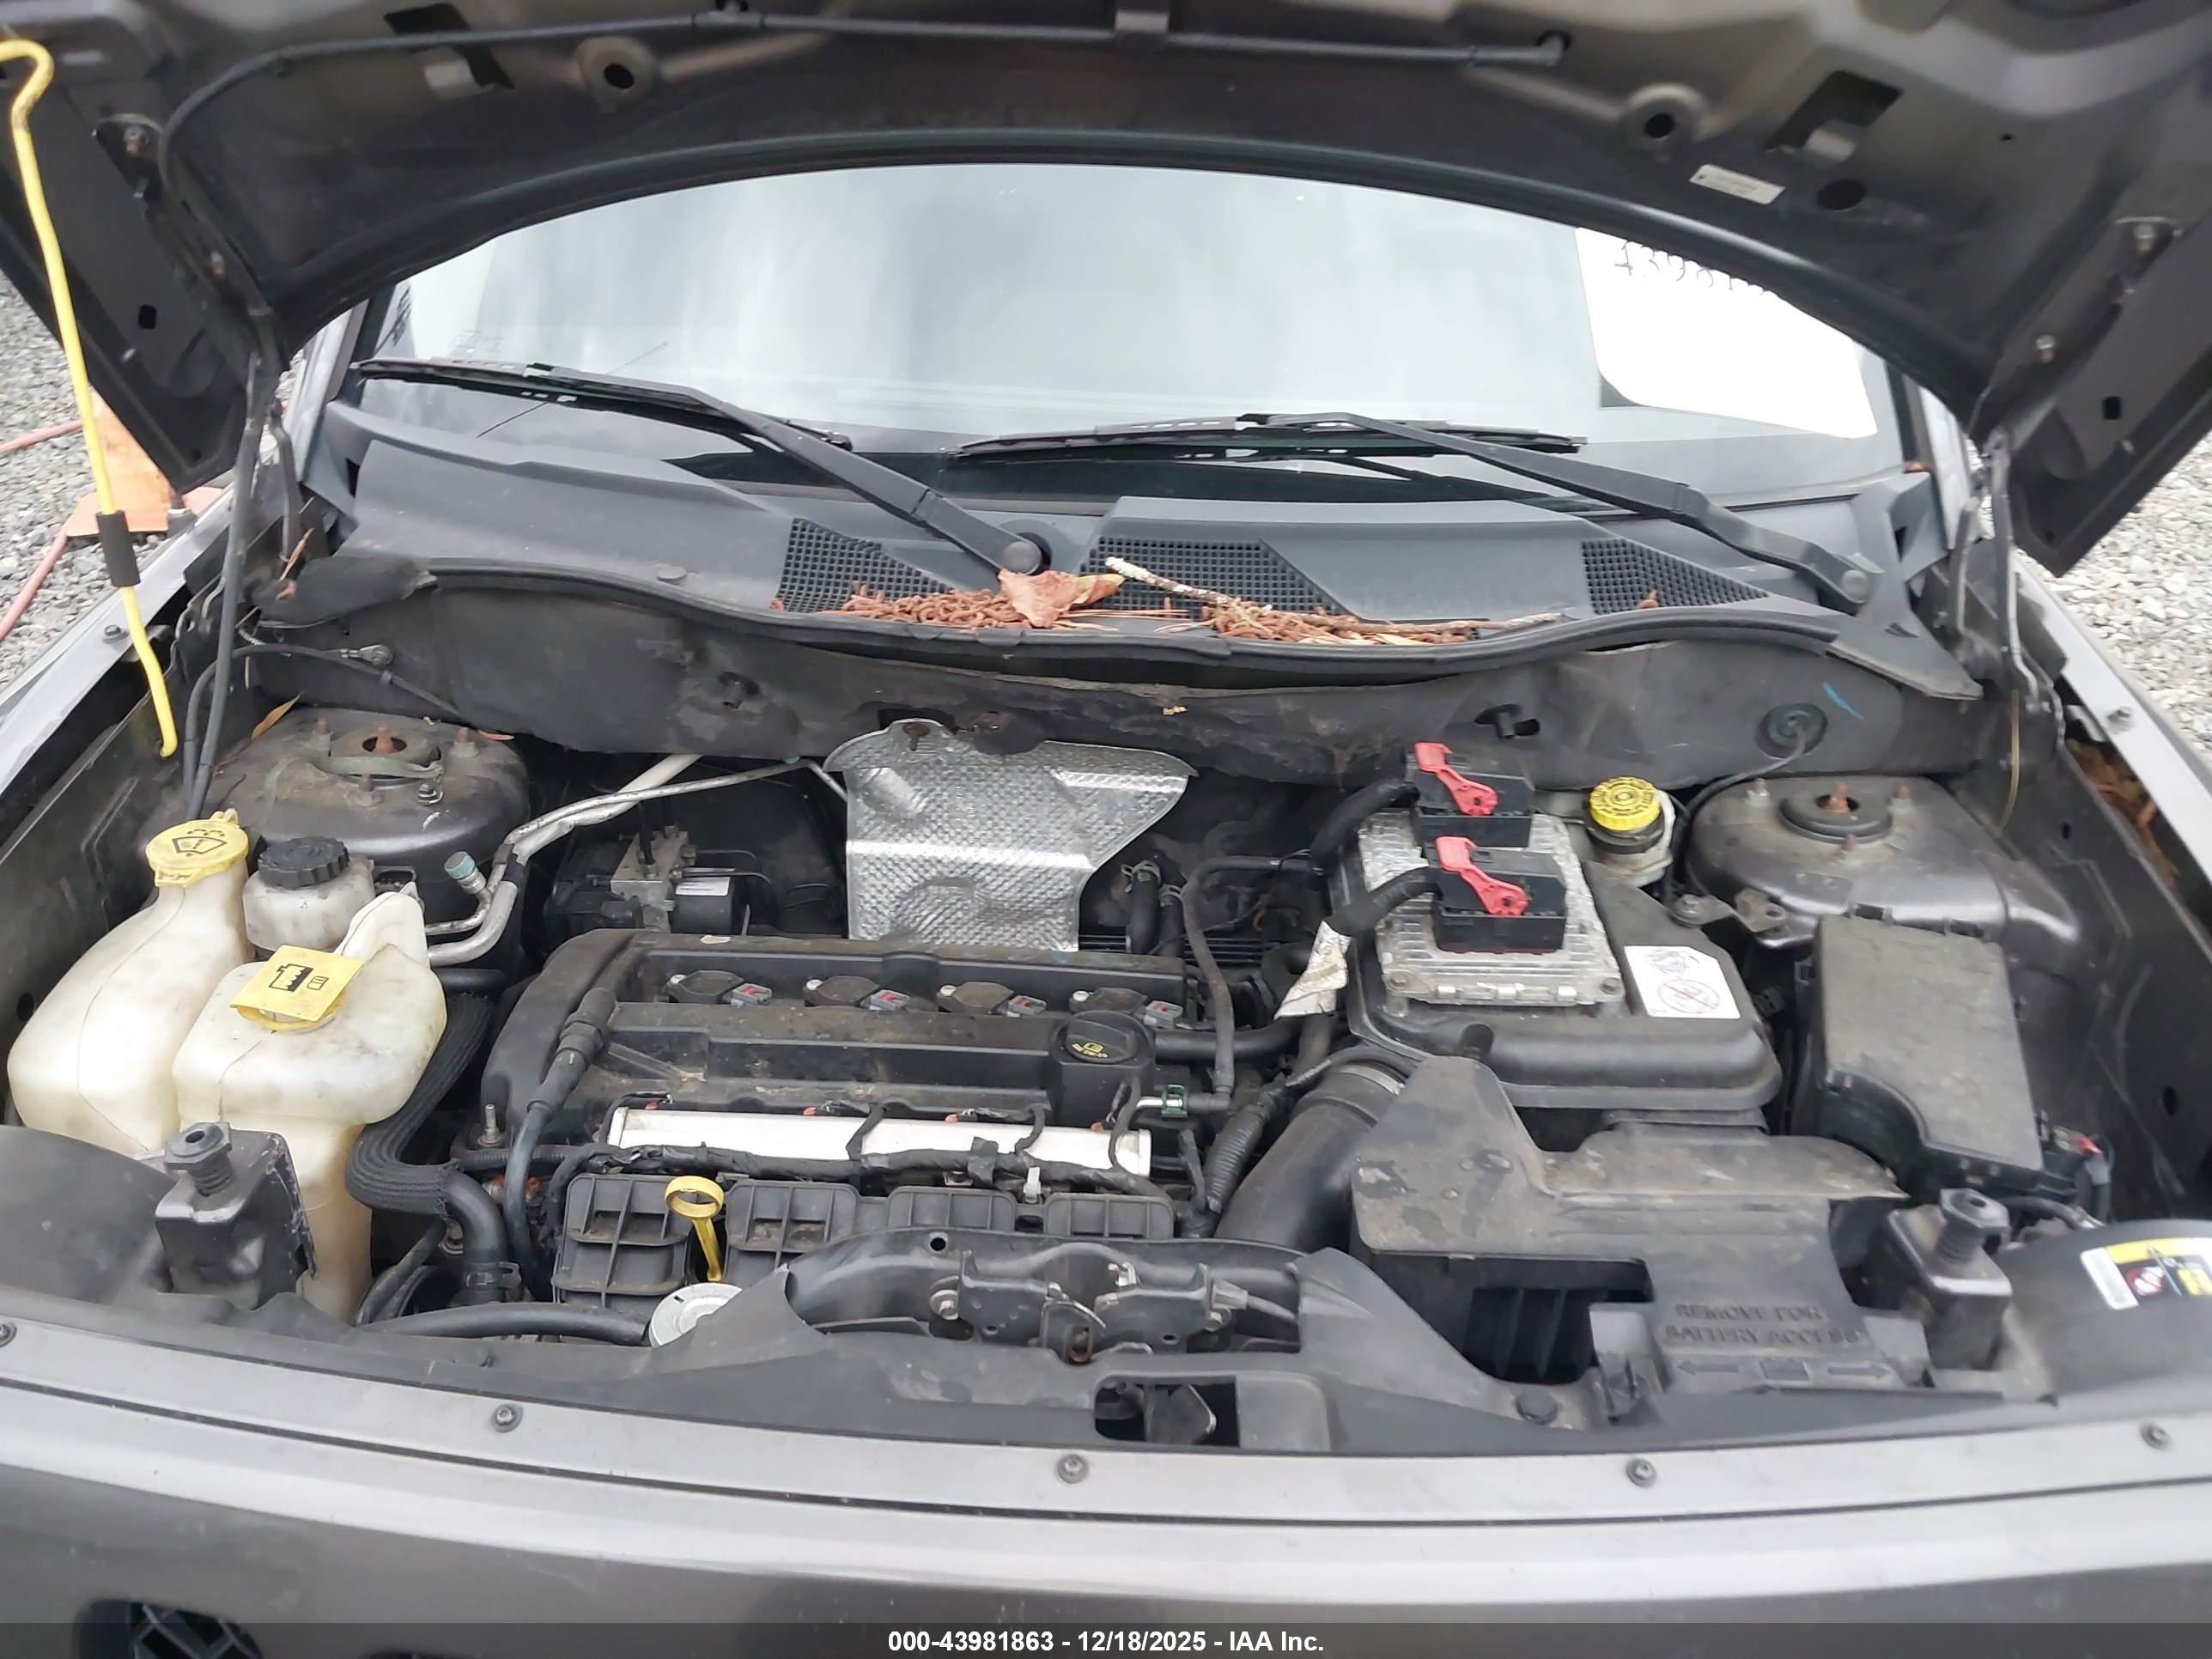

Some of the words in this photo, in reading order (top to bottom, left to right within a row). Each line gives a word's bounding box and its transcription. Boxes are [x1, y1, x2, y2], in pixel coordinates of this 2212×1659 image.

[1674, 1304, 1765, 1321] REMOVE
[1771, 1304, 1826, 1321] FOR
[1664, 1324, 1759, 1344] BATTERY
